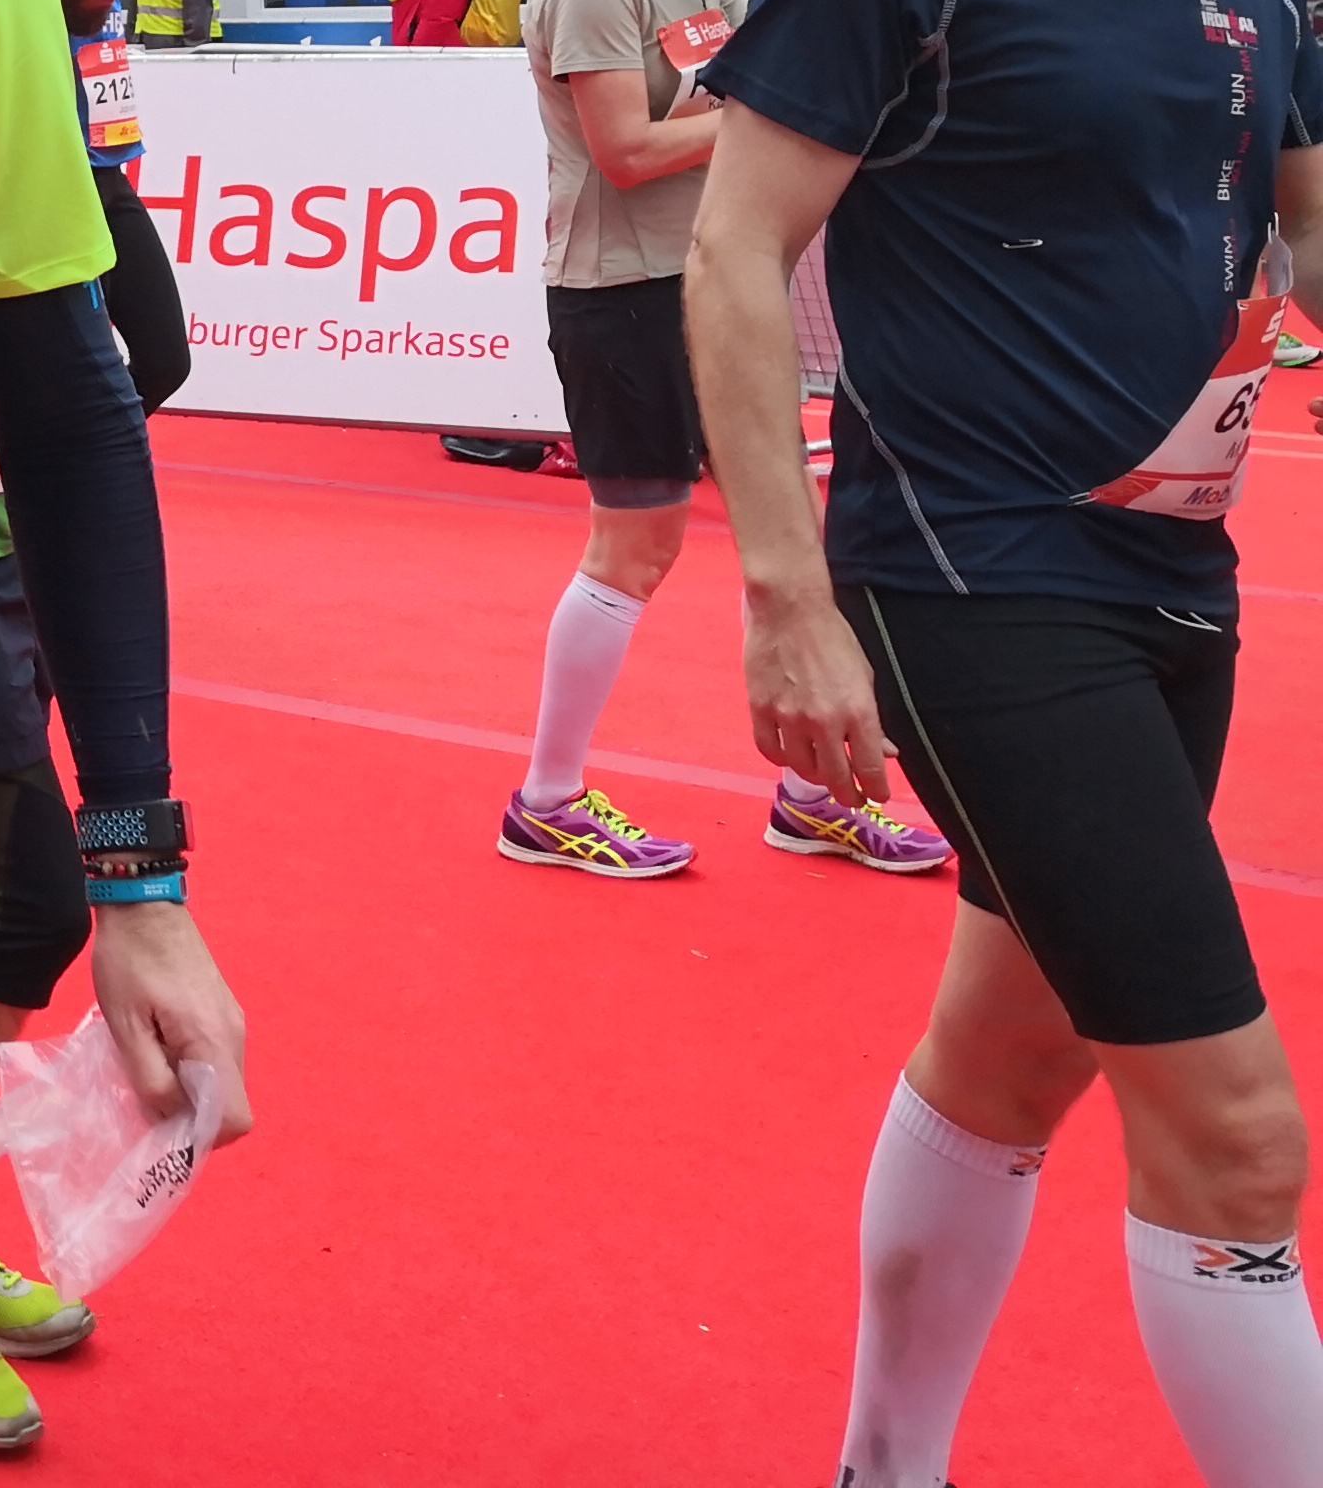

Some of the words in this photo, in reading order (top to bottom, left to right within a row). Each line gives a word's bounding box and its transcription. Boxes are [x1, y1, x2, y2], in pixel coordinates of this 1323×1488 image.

[1230, 73, 1246, 116] RUN
[1217, 159, 1235, 201] BIKE
[120, 155, 520, 303] Haspa
[1222, 235, 1235, 292] SWIM
[318, 319, 511, 361] Sparkasse
